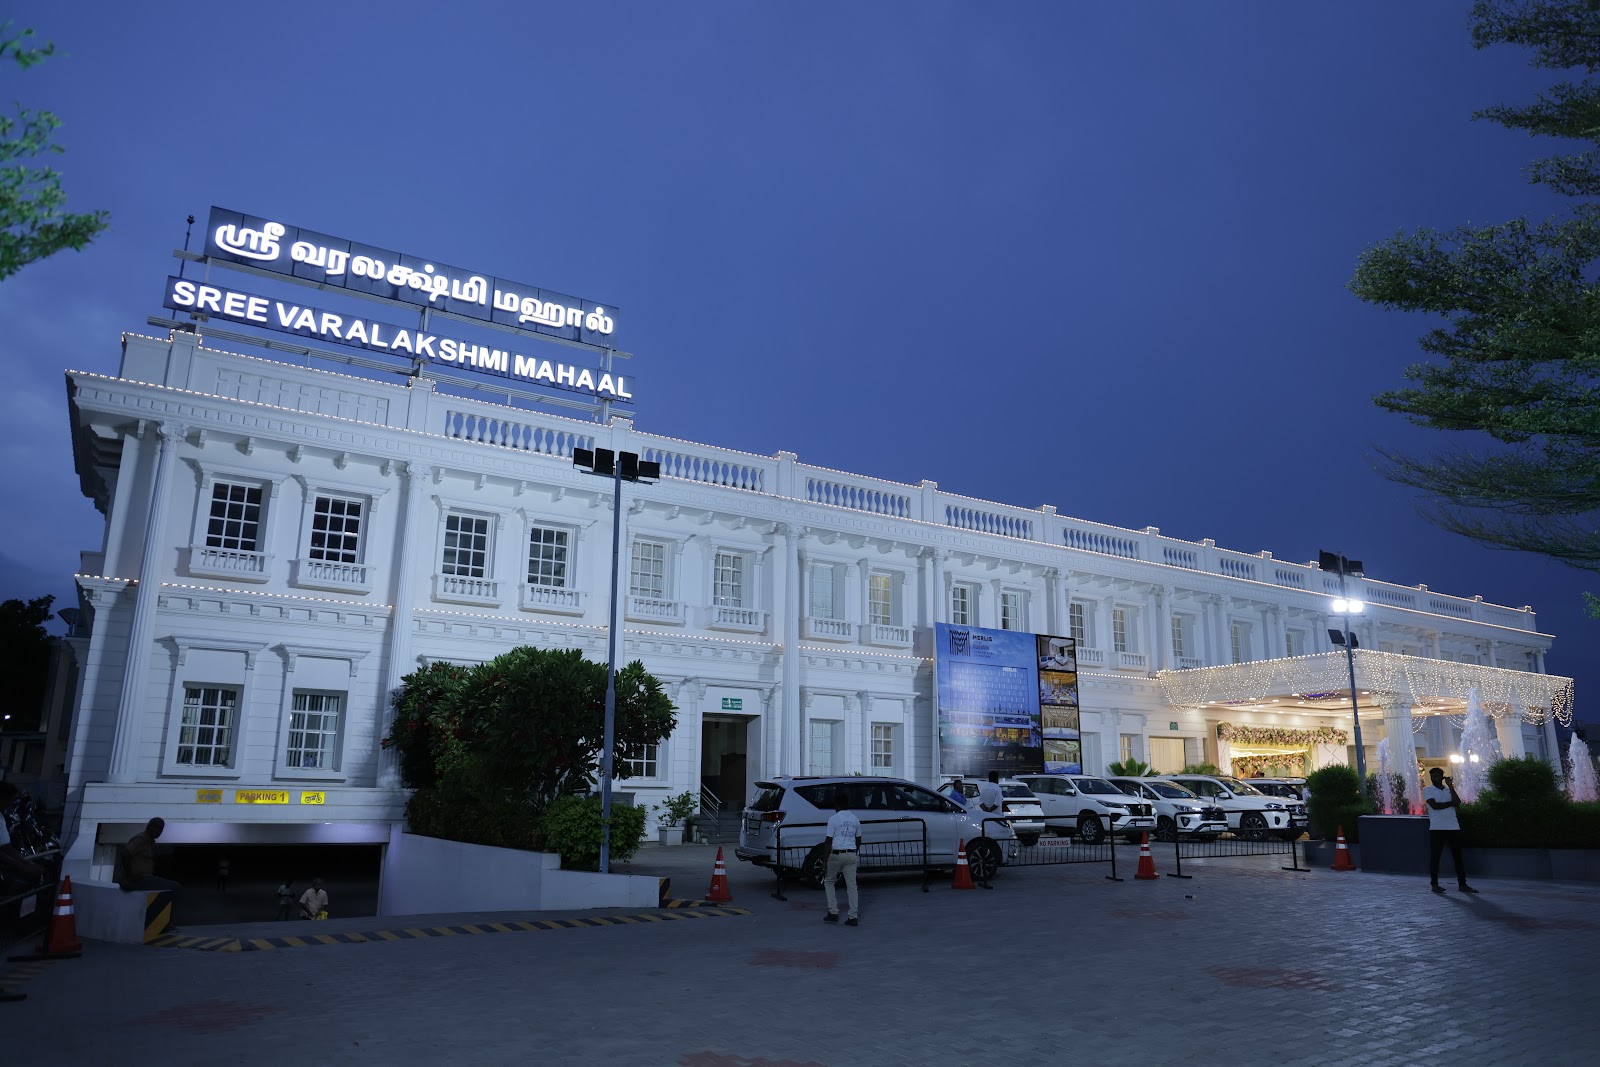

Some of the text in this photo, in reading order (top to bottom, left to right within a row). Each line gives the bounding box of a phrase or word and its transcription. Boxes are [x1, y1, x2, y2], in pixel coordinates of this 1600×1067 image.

[289, 240, 488, 306] வரலக்ஷ்மி
[492, 288, 615, 335] மஹால்
[172, 281, 632, 398] SREE VARALAKSHMI MAHAAL
[239, 792, 285, 802] PARKING 1
